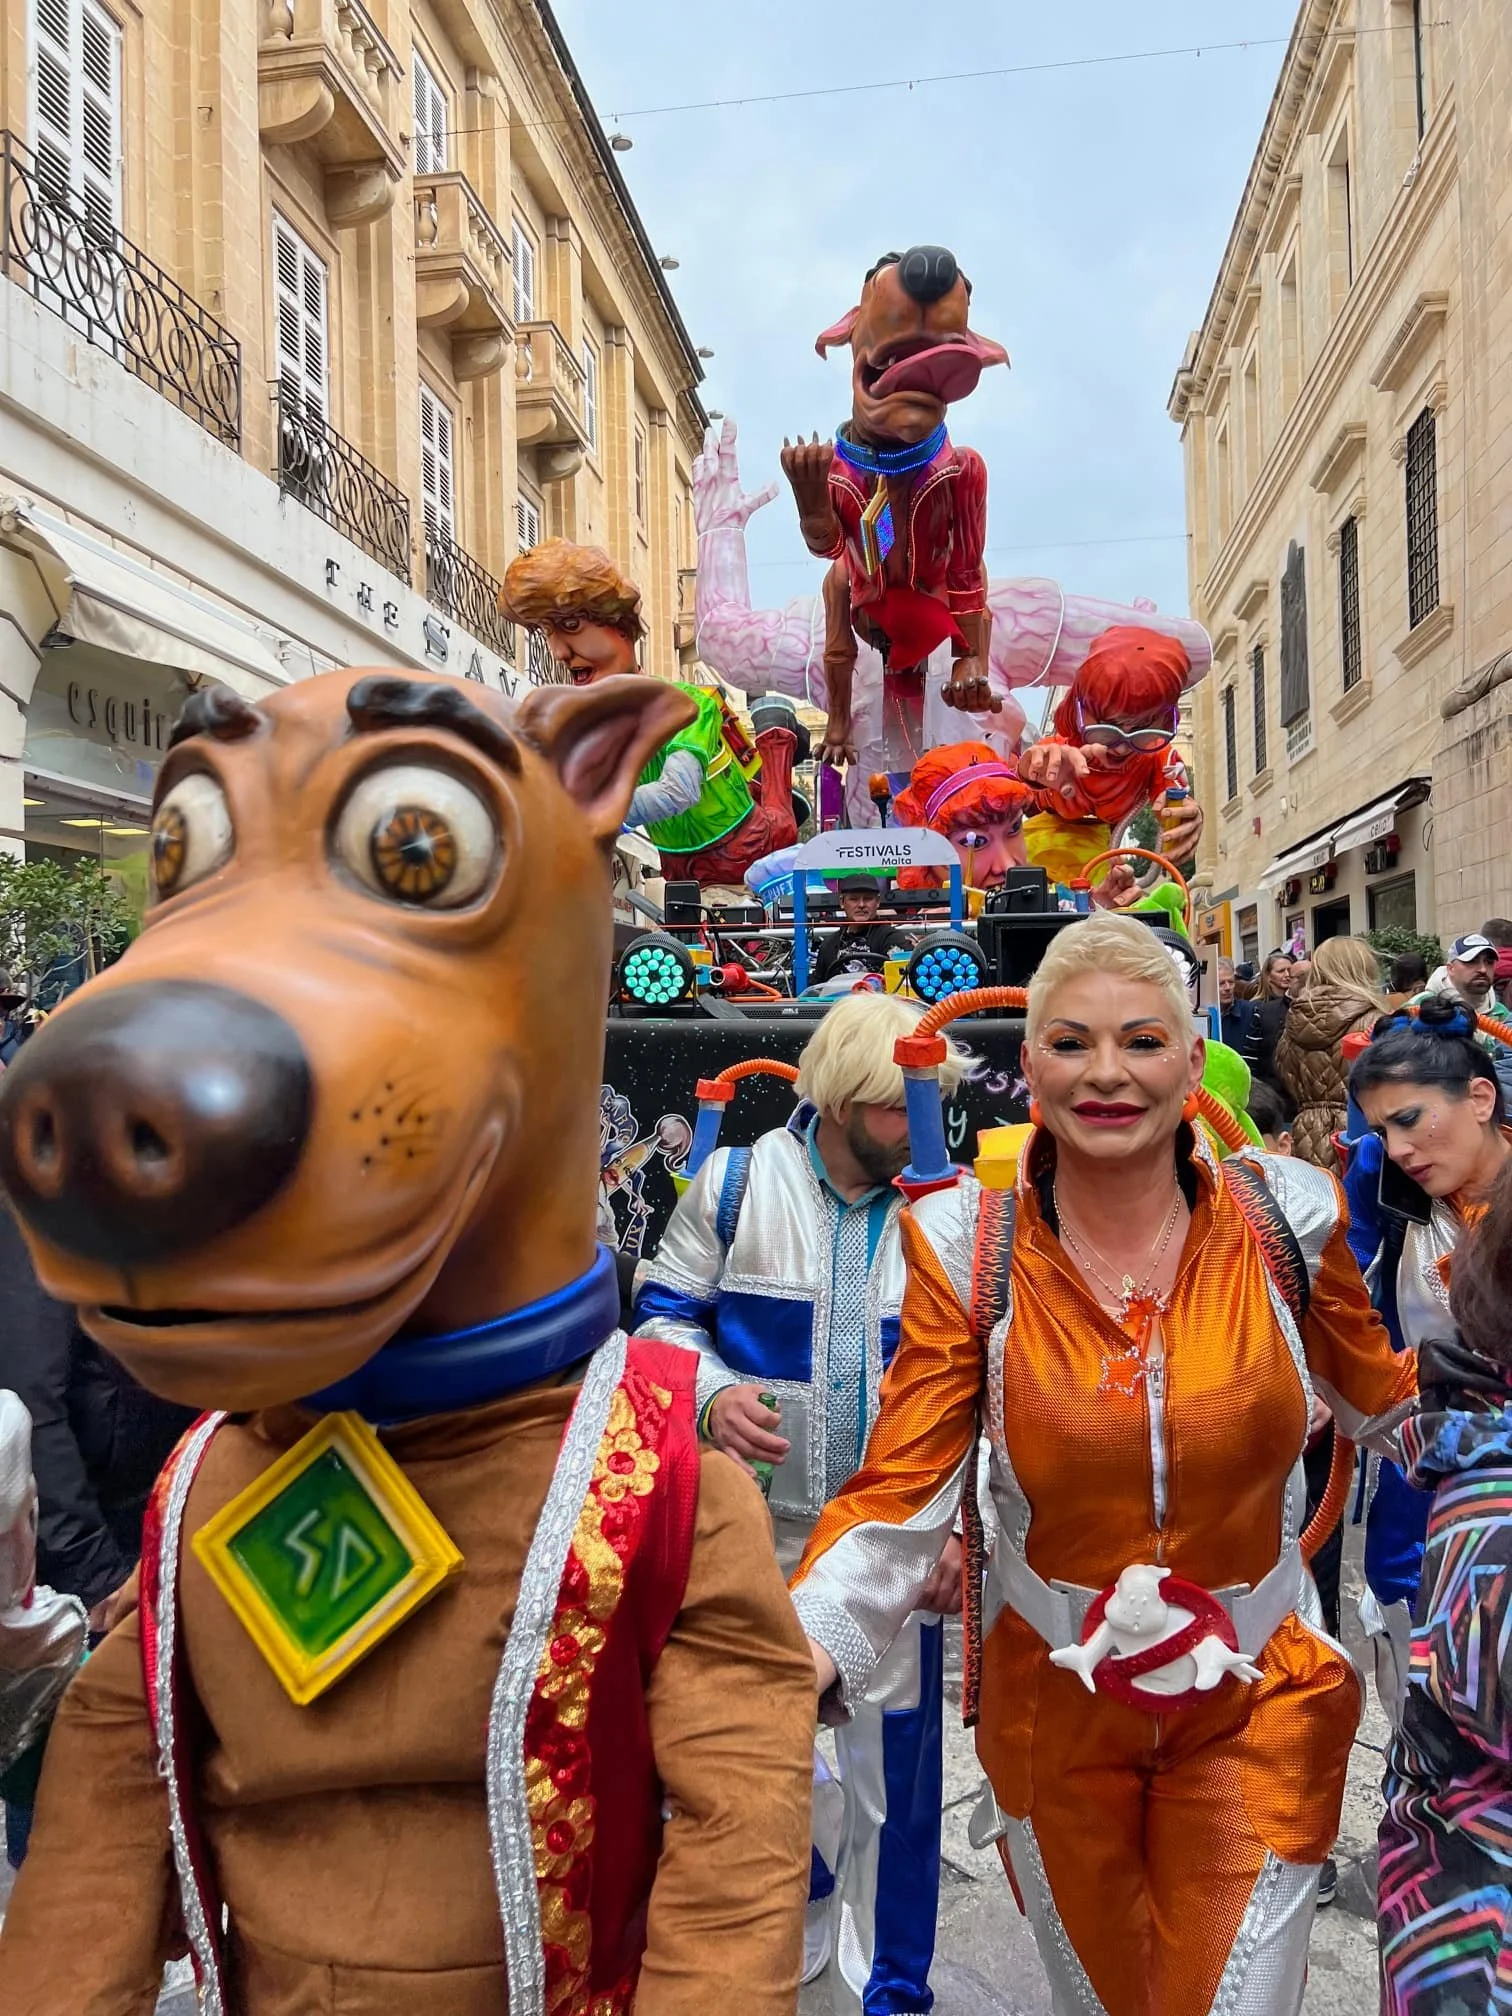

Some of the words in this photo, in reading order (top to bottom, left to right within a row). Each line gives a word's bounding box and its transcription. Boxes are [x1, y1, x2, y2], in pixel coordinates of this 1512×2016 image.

[325, 557, 400, 629] THE
[836, 845, 912, 858] FESTIVALS
[881, 857, 912, 866] Malta
[284, 1508, 382, 1602] SD
